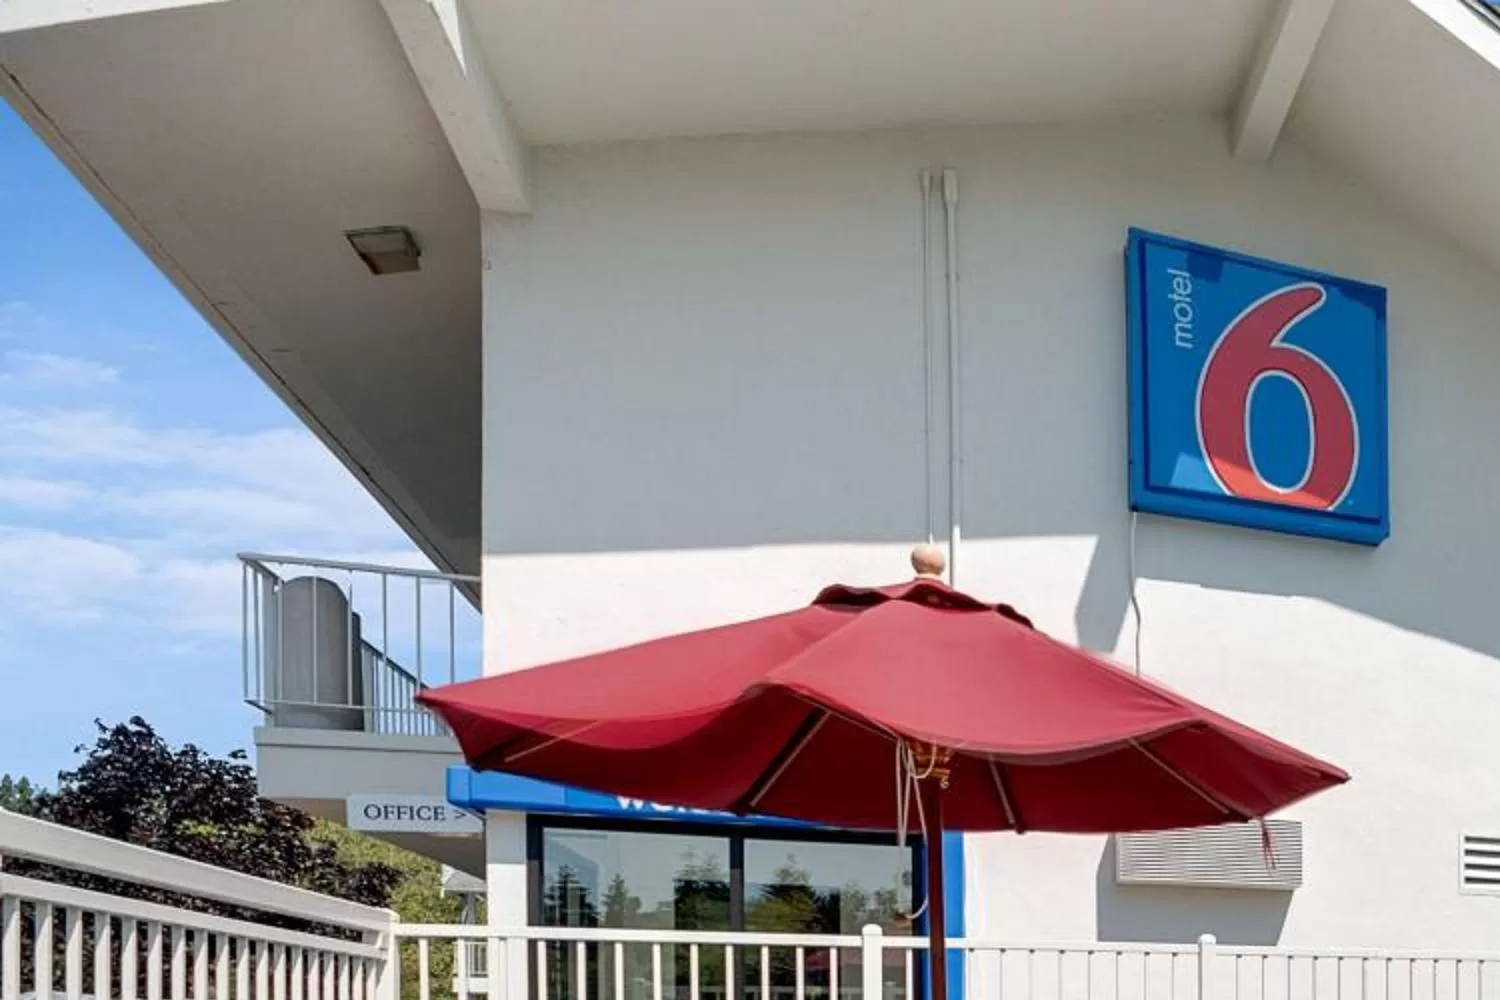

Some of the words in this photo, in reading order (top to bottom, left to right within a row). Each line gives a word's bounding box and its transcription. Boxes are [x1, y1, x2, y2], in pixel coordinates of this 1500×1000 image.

[1167, 268, 1193, 349] motel
[1195, 281, 1360, 512] 6
[362, 803, 447, 821] OFFICE
